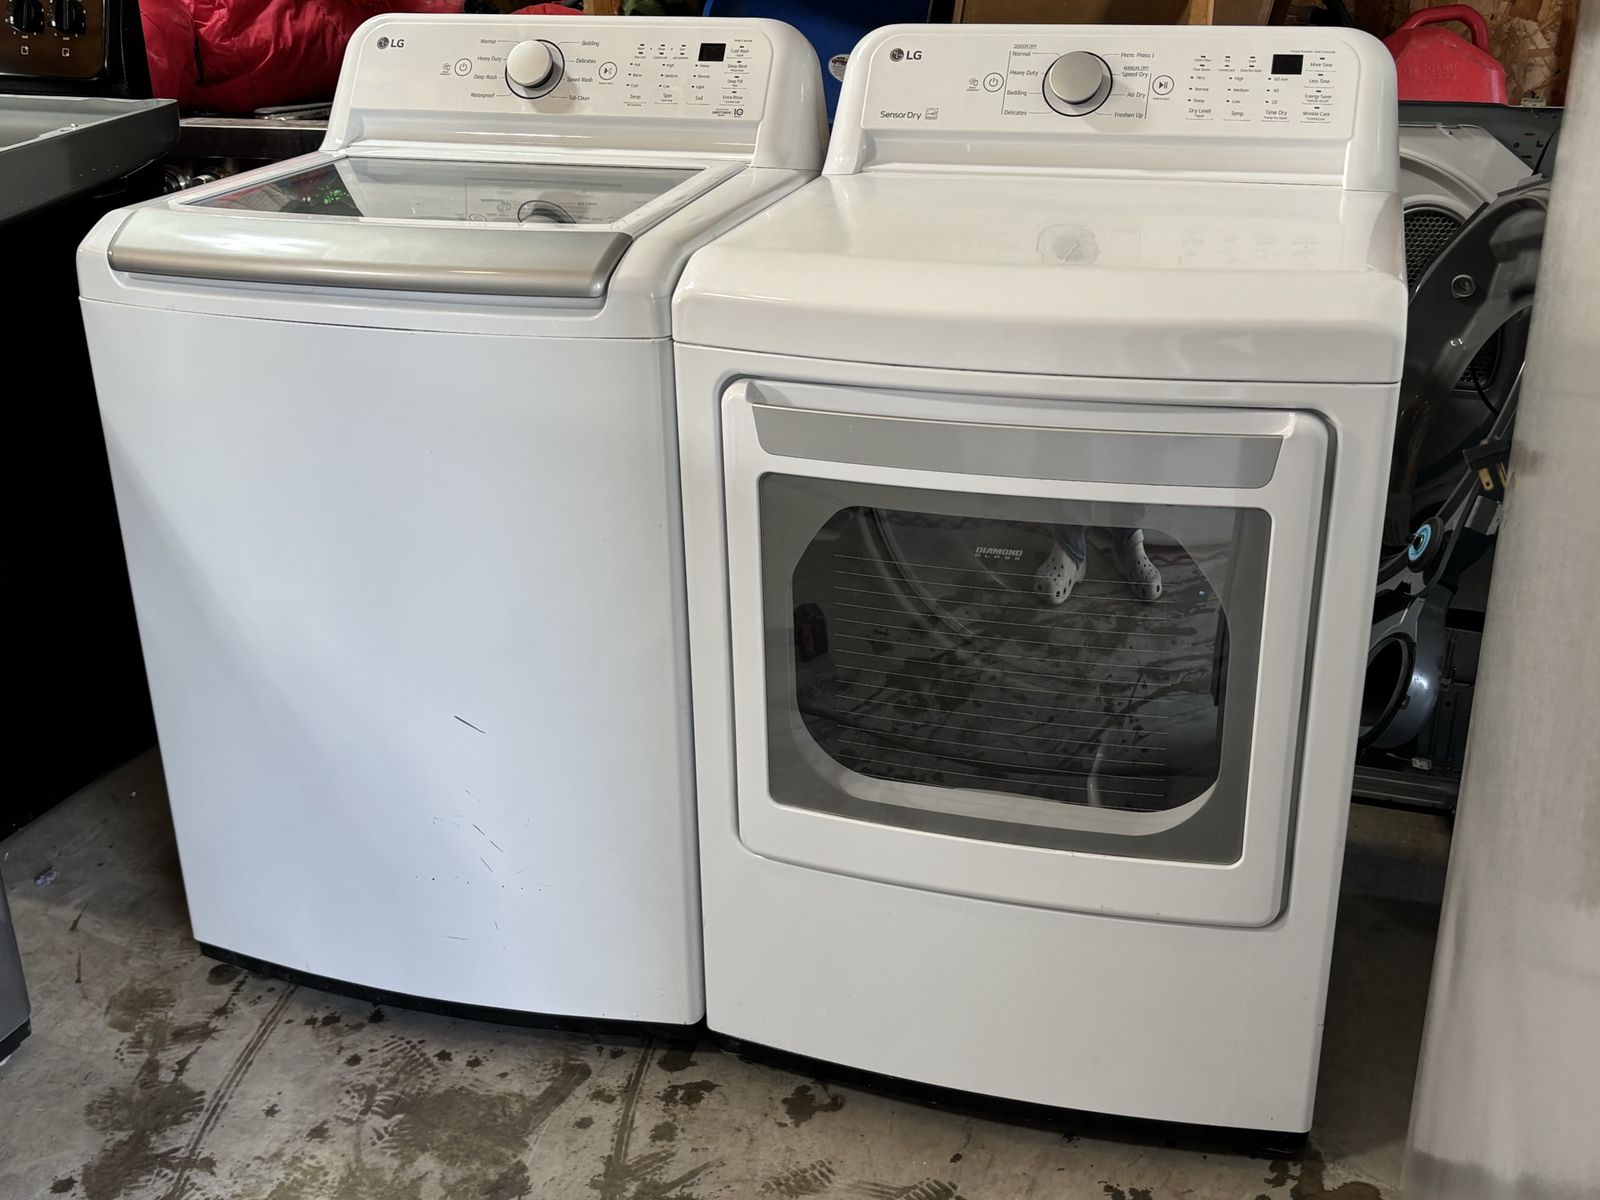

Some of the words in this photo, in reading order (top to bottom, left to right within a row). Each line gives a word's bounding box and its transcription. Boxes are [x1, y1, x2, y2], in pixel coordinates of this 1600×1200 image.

[390, 38, 405, 48] LG
[906, 50, 923, 60] LG
[1136, 91, 1146, 99] Dry
[975, 546, 1023, 557] DIAMOND
